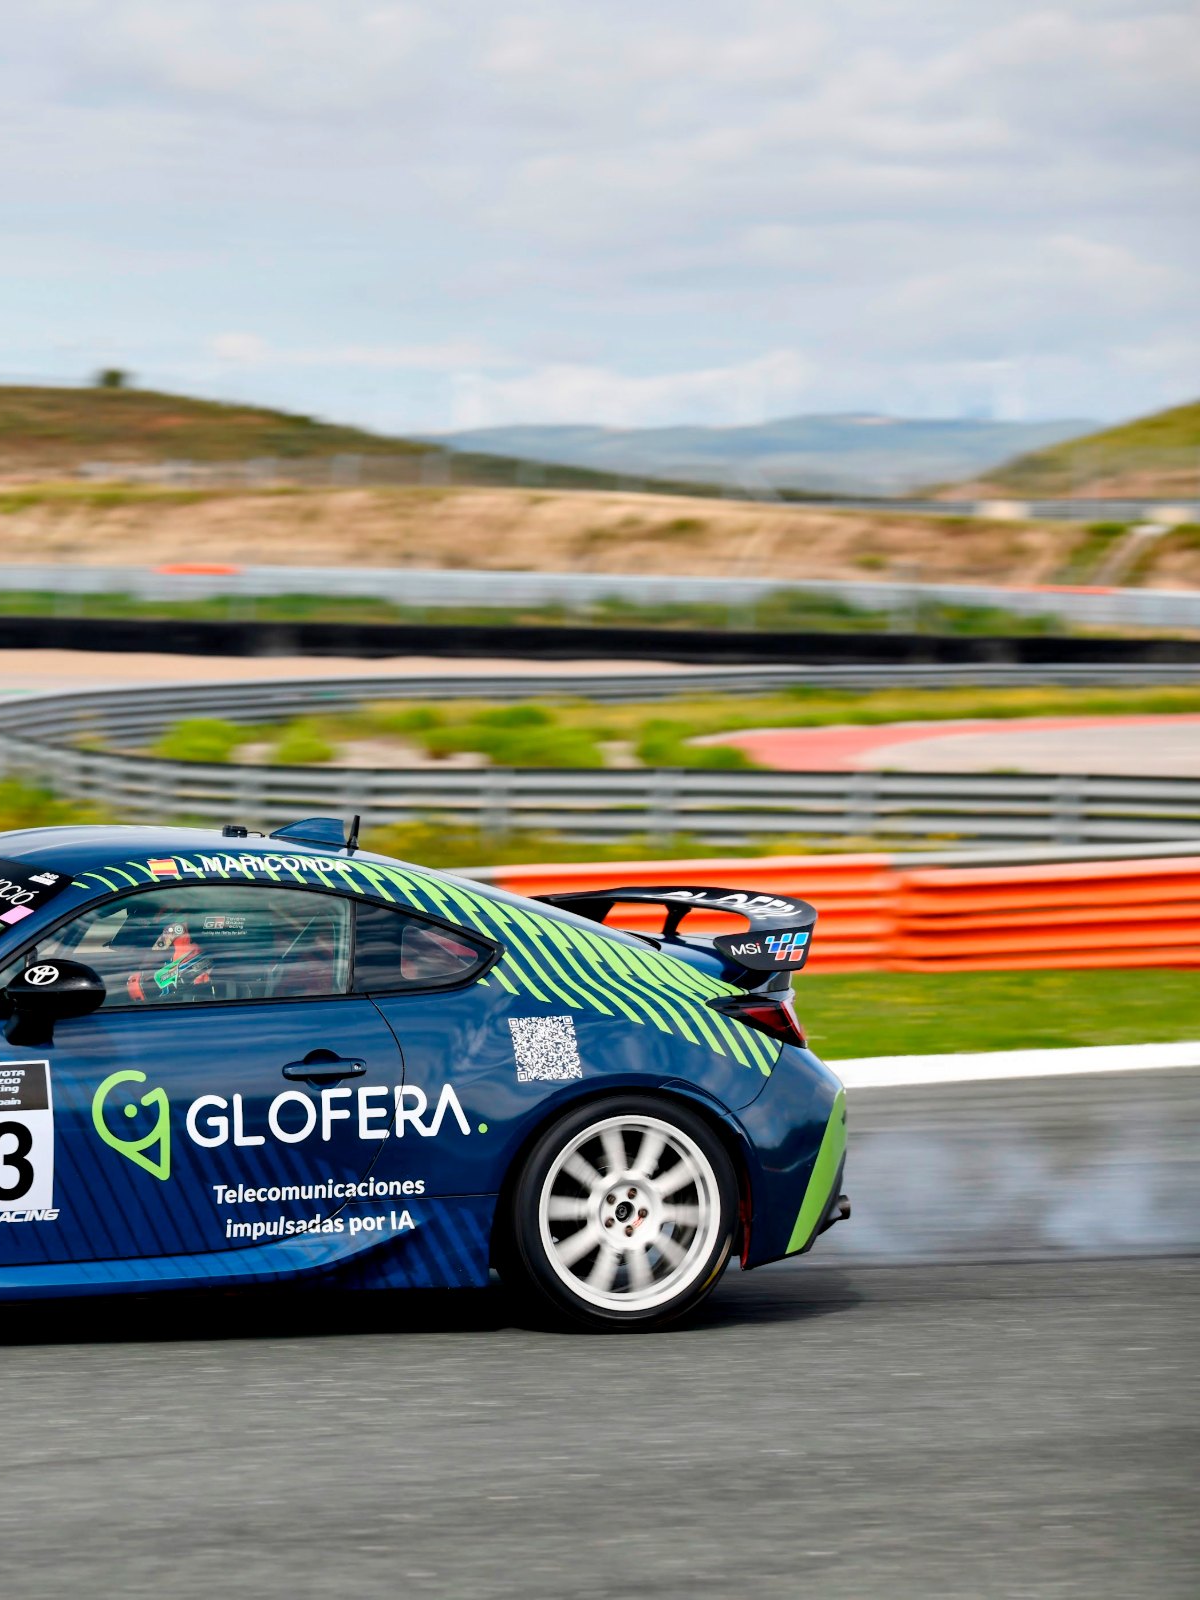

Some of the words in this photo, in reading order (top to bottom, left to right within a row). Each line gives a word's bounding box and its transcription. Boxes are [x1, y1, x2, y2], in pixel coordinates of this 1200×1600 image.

[213, 1176, 425, 1204] Telecomunicaciones
[225, 1213, 345, 1240] impulsadas
[349, 1214, 384, 1236] por
[390, 1209, 415, 1231] IA
